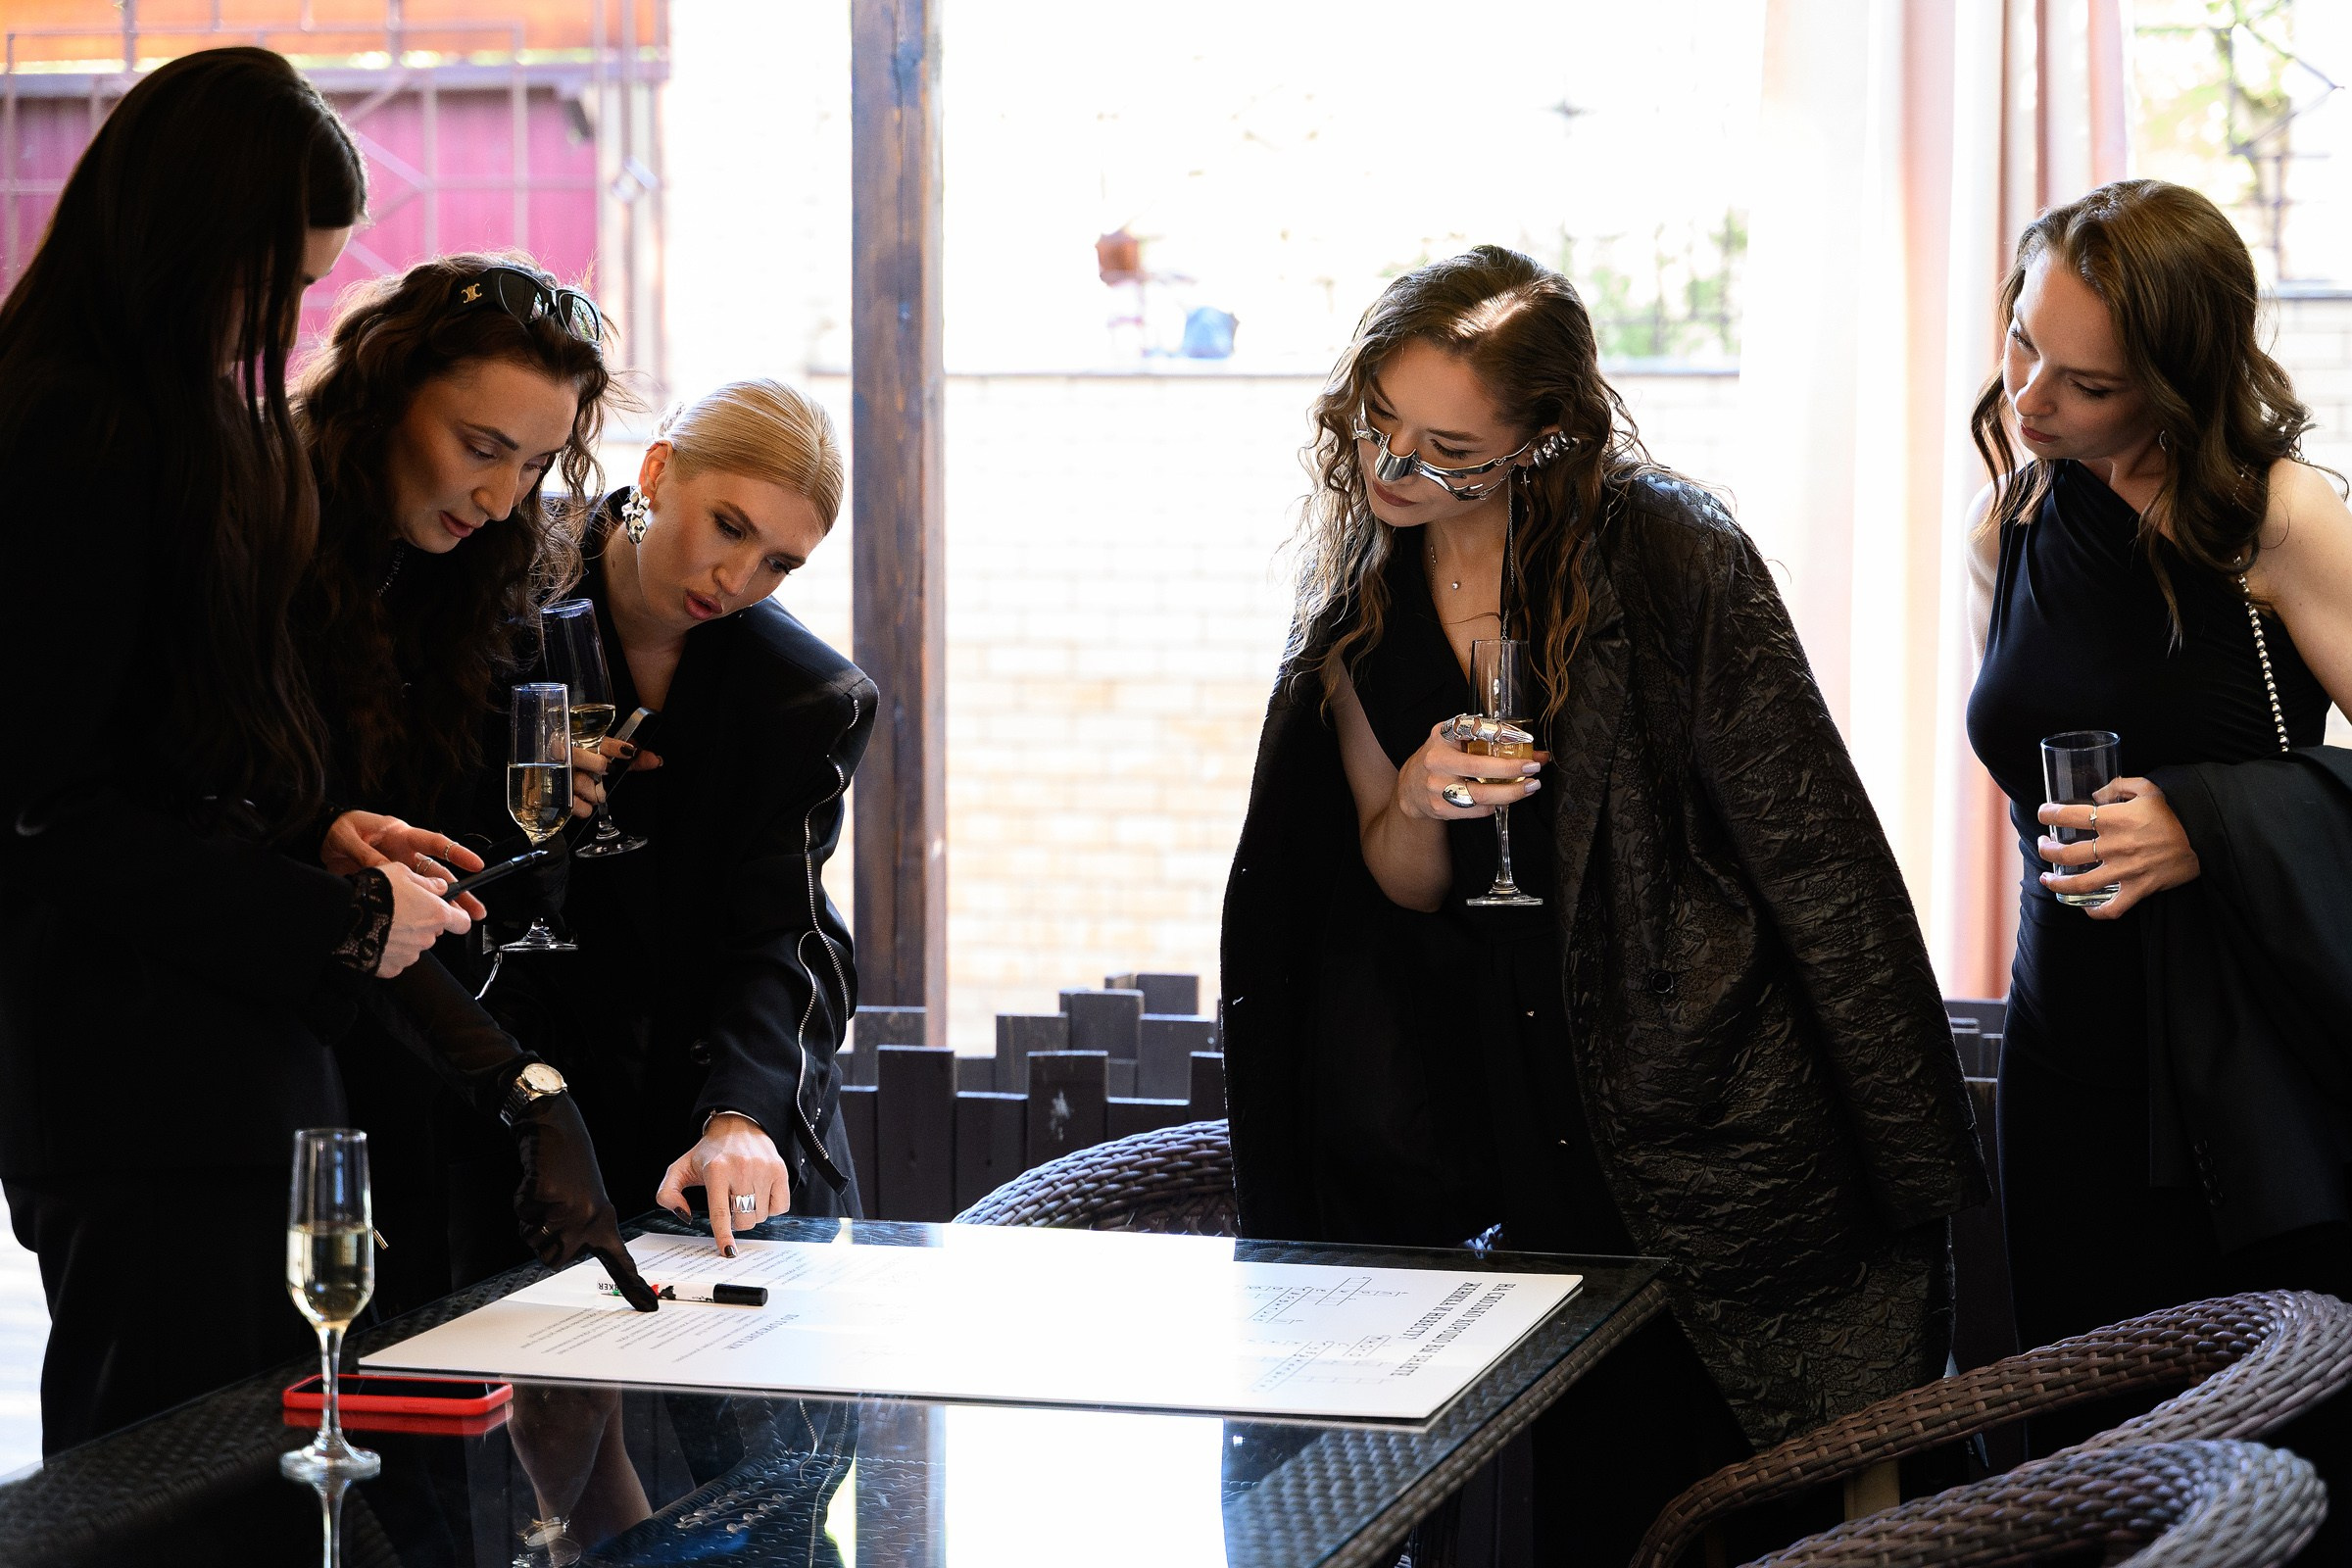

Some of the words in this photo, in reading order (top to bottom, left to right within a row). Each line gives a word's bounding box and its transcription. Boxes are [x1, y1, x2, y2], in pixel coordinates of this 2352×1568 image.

[1438, 1281, 1484, 1306] ЖЕНИХА
[1492, 1282, 1518, 1293] НА
[1461, 1291, 1507, 1318] СКОЛЬКО
[1398, 1311, 1448, 1340] НЕВЕСТУ?
[1432, 1317, 1476, 1344] ХОРОШО
[1419, 1345, 1446, 1353] ВЫ
[1390, 1355, 1433, 1376] ЗНАЕТЕ
